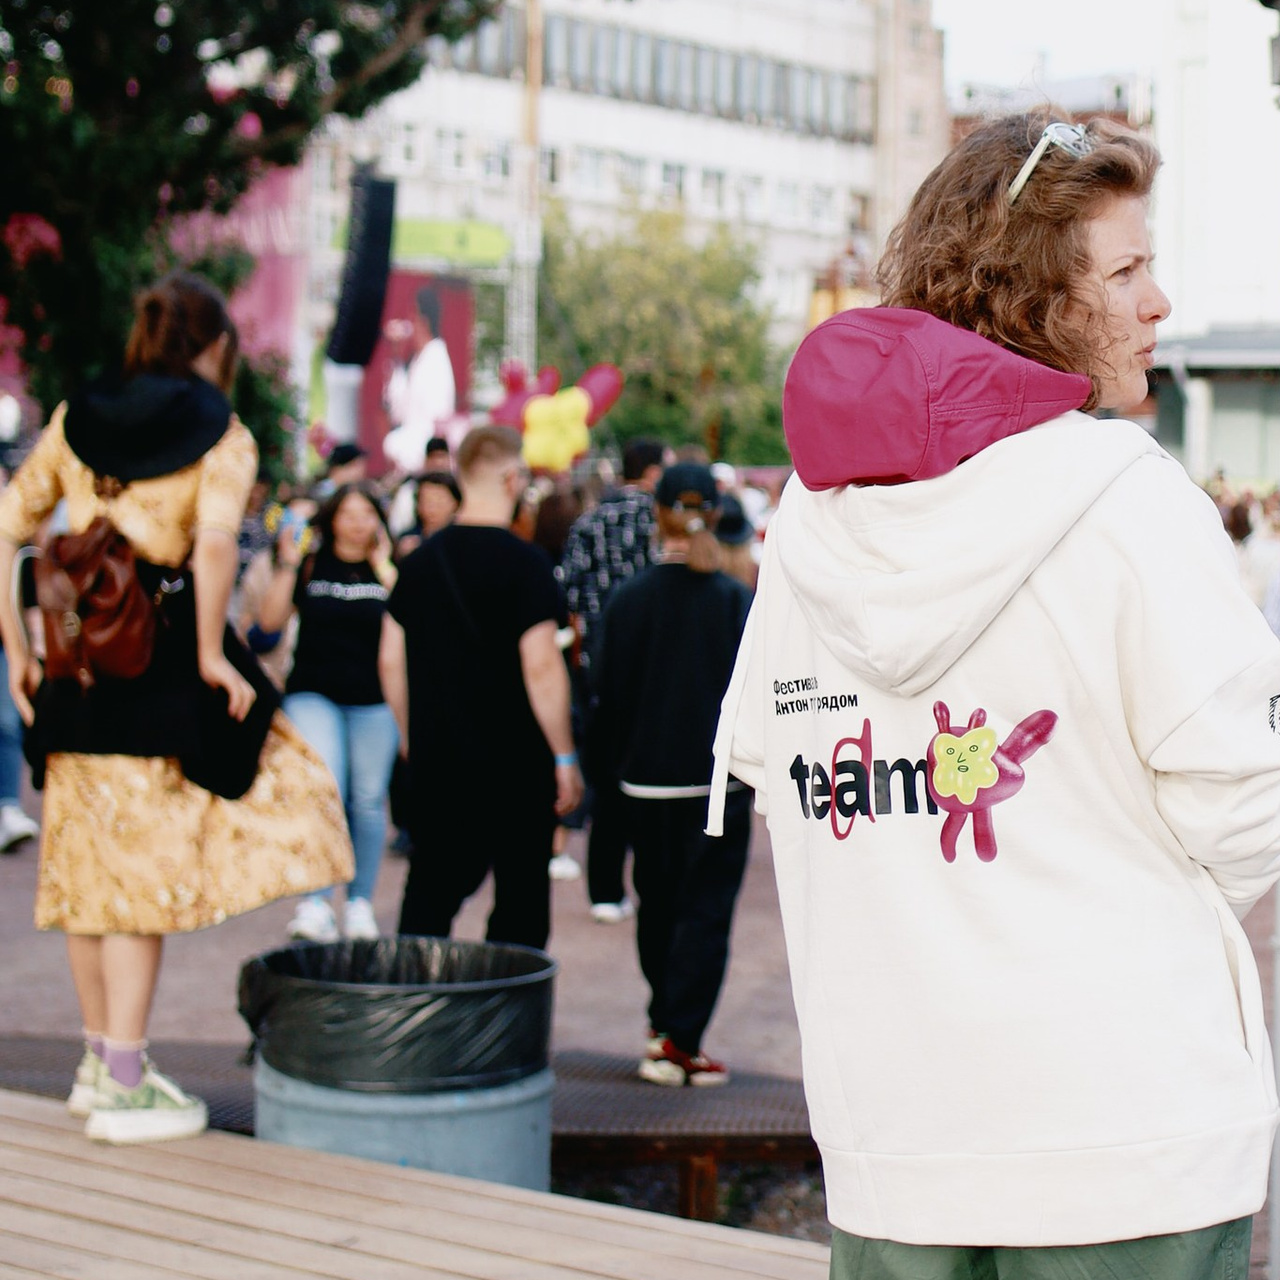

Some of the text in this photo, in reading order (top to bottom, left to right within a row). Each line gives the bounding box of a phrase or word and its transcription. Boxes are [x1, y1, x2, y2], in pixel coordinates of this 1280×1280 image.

[775, 698, 809, 716] Антон
[817, 694, 858, 715] рядом
[789, 754, 939, 820] team
